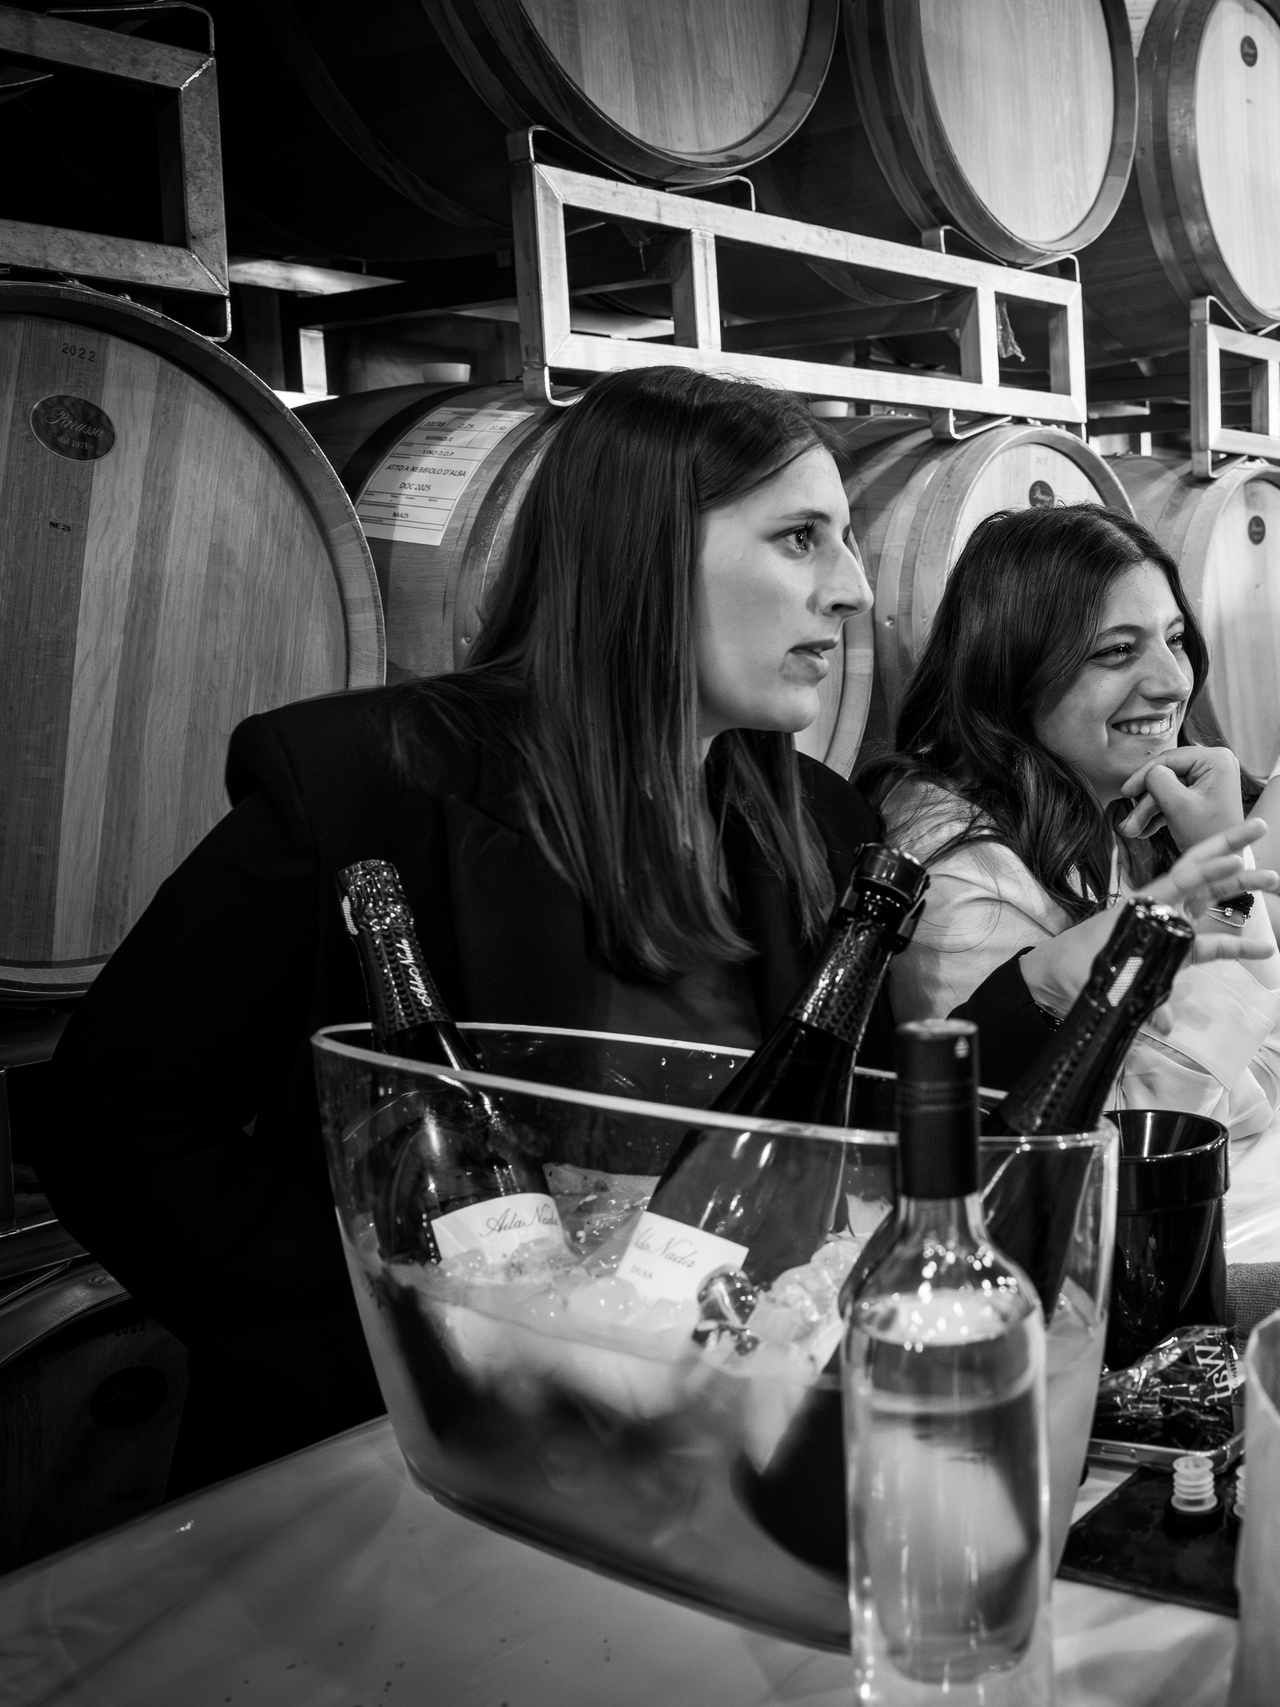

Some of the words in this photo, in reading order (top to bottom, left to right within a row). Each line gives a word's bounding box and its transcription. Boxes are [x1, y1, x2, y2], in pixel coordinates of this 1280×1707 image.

[62, 343, 96, 362] 2022
[44, 405, 105, 436] Parusso
[58, 435, 70, 446] dal
[72, 440, 88, 449] 1971
[399, 481, 415, 490] DOC
[410, 465, 443, 475] NEBBIOLO
[443, 468, 467, 477] D'ALBA
[396, 938, 419, 977] Nada
[409, 976, 433, 1007] Ada
[479, 1206, 526, 1238] Ada
[649, 1236, 698, 1269] Nada
